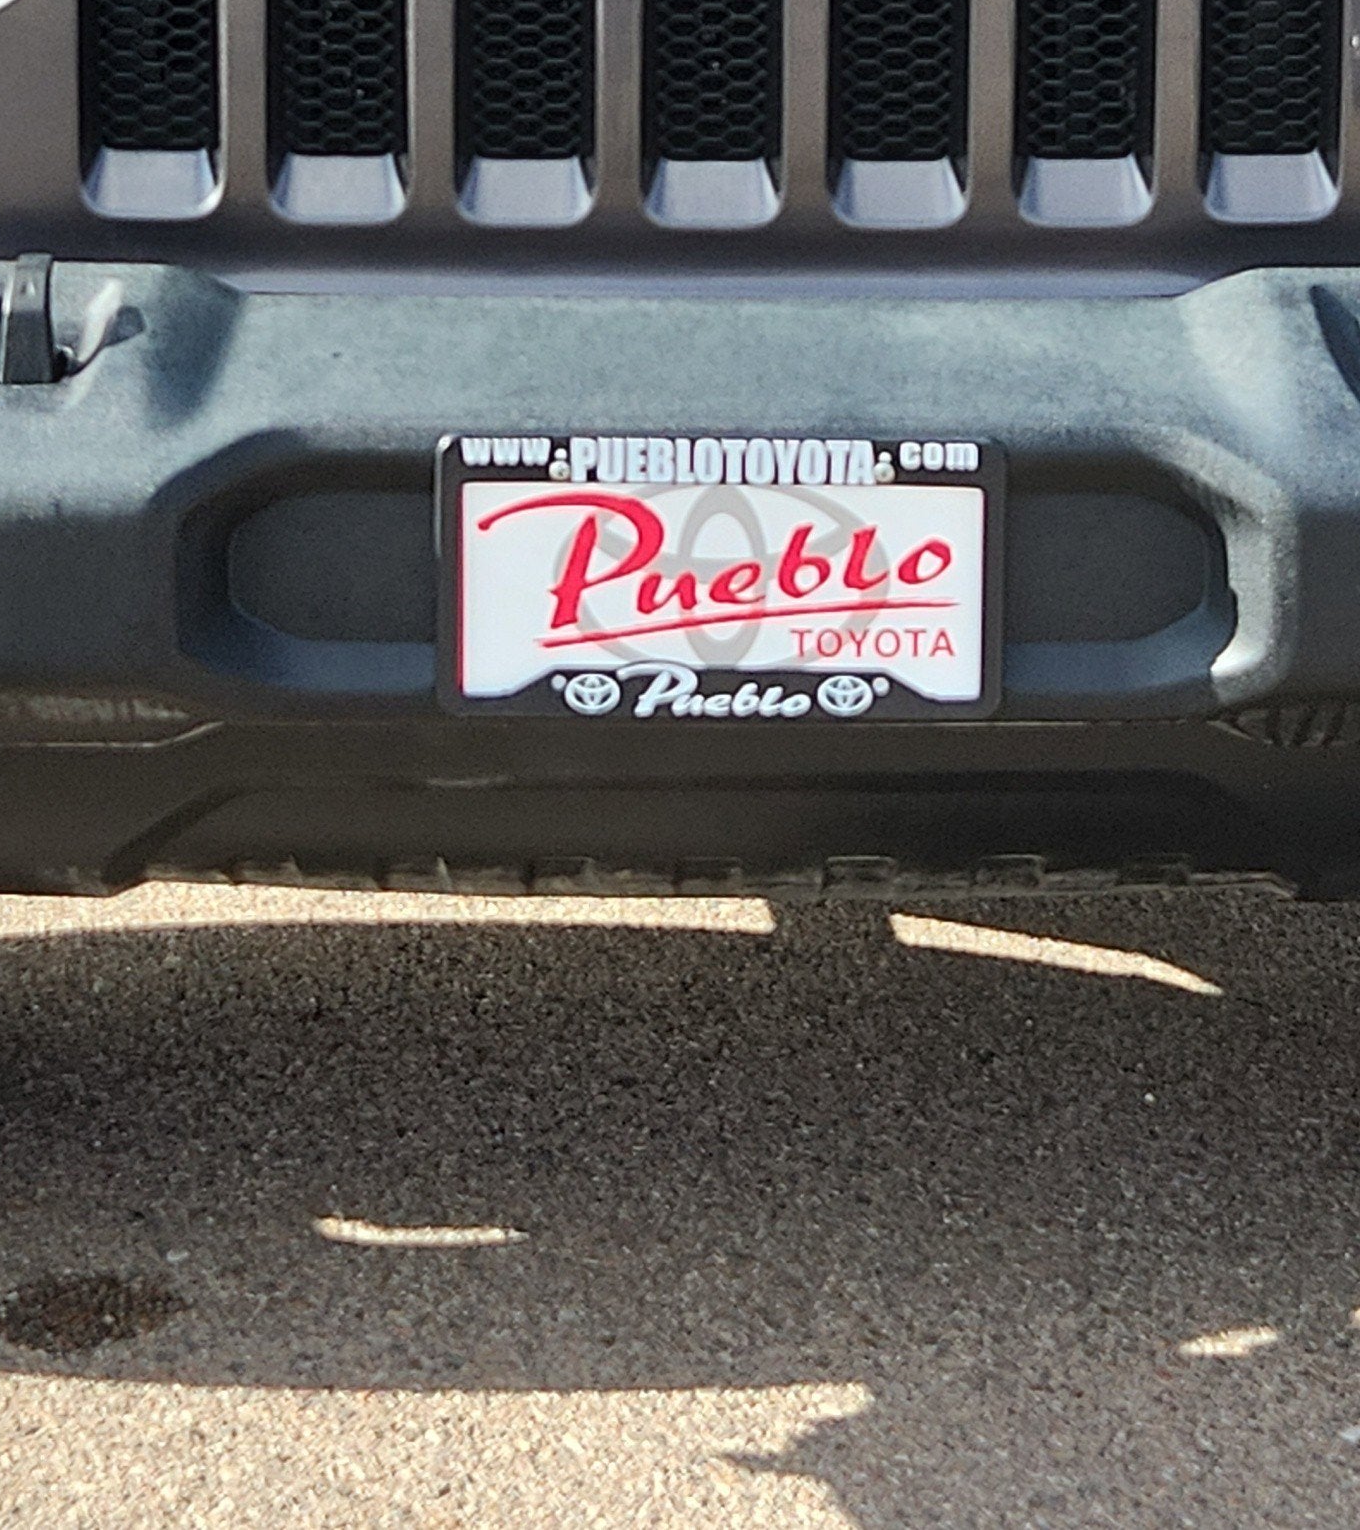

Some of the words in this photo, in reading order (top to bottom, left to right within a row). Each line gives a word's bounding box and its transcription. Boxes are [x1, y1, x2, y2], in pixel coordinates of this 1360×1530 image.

[478, 492, 952, 629] Pueblo
[791, 628, 955, 657] TOYOTA
[617, 661, 811, 718] Pueblo
